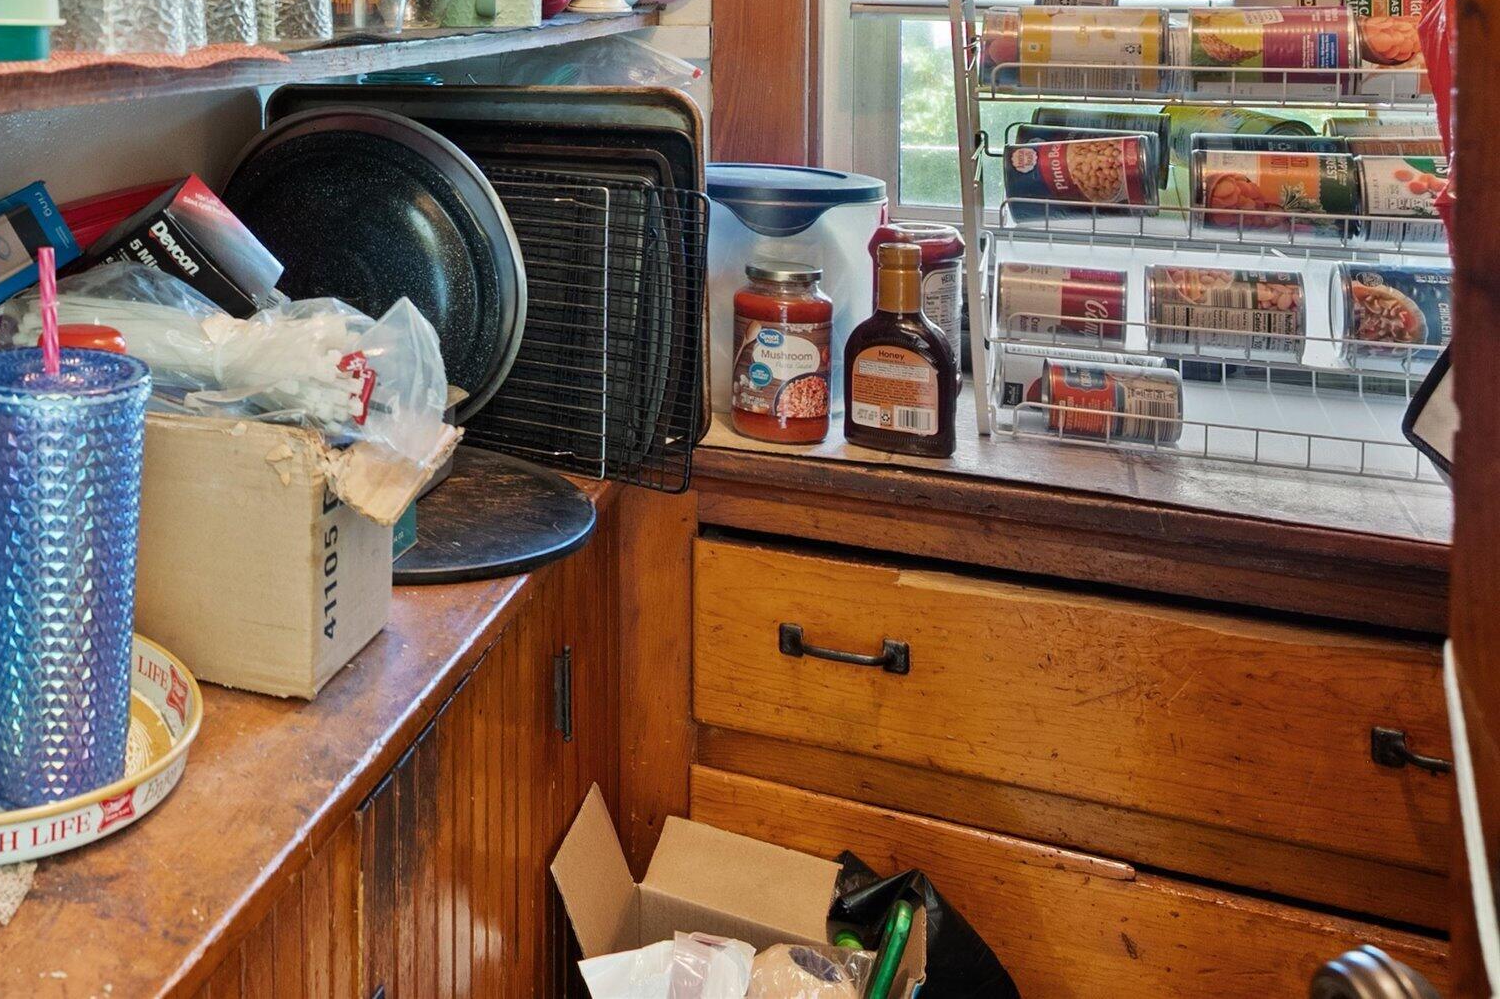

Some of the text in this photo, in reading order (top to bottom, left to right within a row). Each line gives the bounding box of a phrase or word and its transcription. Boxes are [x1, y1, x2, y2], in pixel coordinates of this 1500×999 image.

[1050, 157, 1070, 191] Pinto
[34, 190, 54, 218] ring
[129, 237, 142, 252] 5
[150, 219, 201, 278] Devcon
[1437, 302, 1453, 335] CHICKEN
[760, 349, 814, 361] Mushroom
[878, 349, 906, 361] Honey
[323, 524, 341, 640] 41105
[137, 654, 169, 689] LIFE
[30, 810, 93, 848] LIFE
